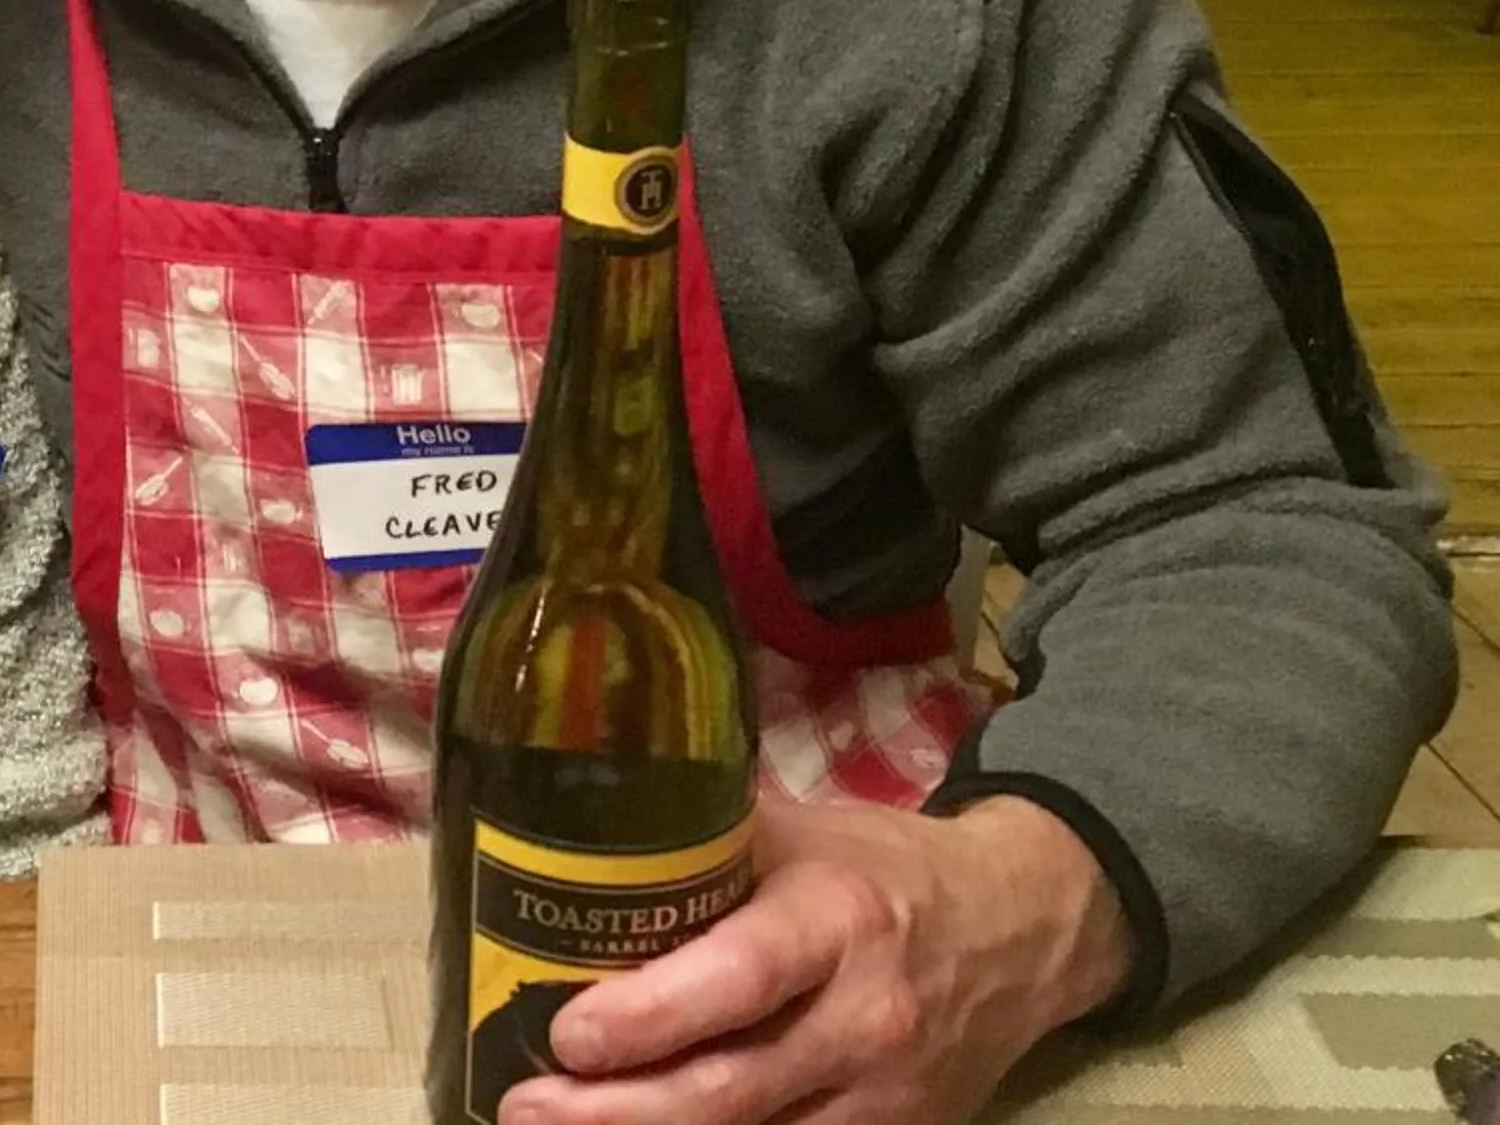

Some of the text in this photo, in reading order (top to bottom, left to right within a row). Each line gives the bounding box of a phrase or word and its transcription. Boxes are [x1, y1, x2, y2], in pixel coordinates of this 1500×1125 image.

[396, 424, 472, 445] Hello
[424, 446, 461, 456] name
[410, 470, 498, 499] FRED
[513, 887, 679, 935] TOASTED
